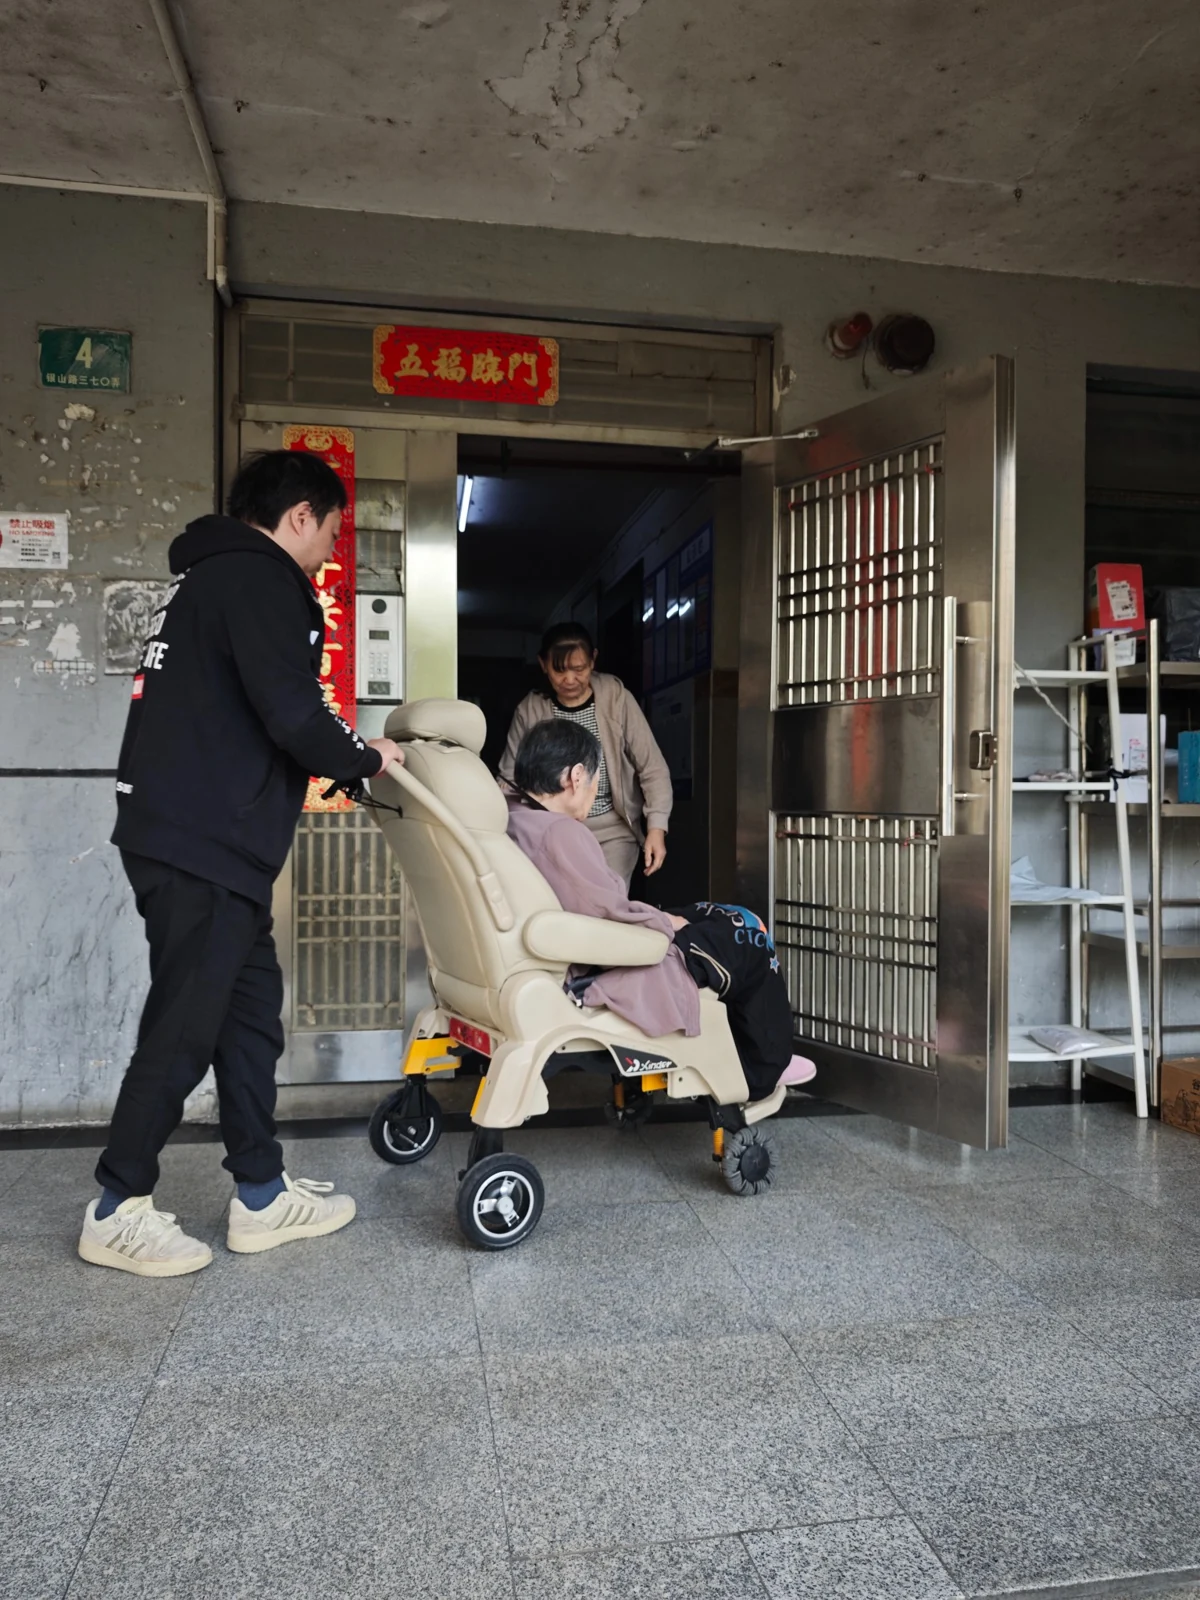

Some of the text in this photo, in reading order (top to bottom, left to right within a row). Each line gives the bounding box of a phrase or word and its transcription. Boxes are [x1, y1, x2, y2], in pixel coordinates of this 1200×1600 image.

[75, 337, 93, 369] 4
[9, 518, 56, 530] 禁止吸烟
